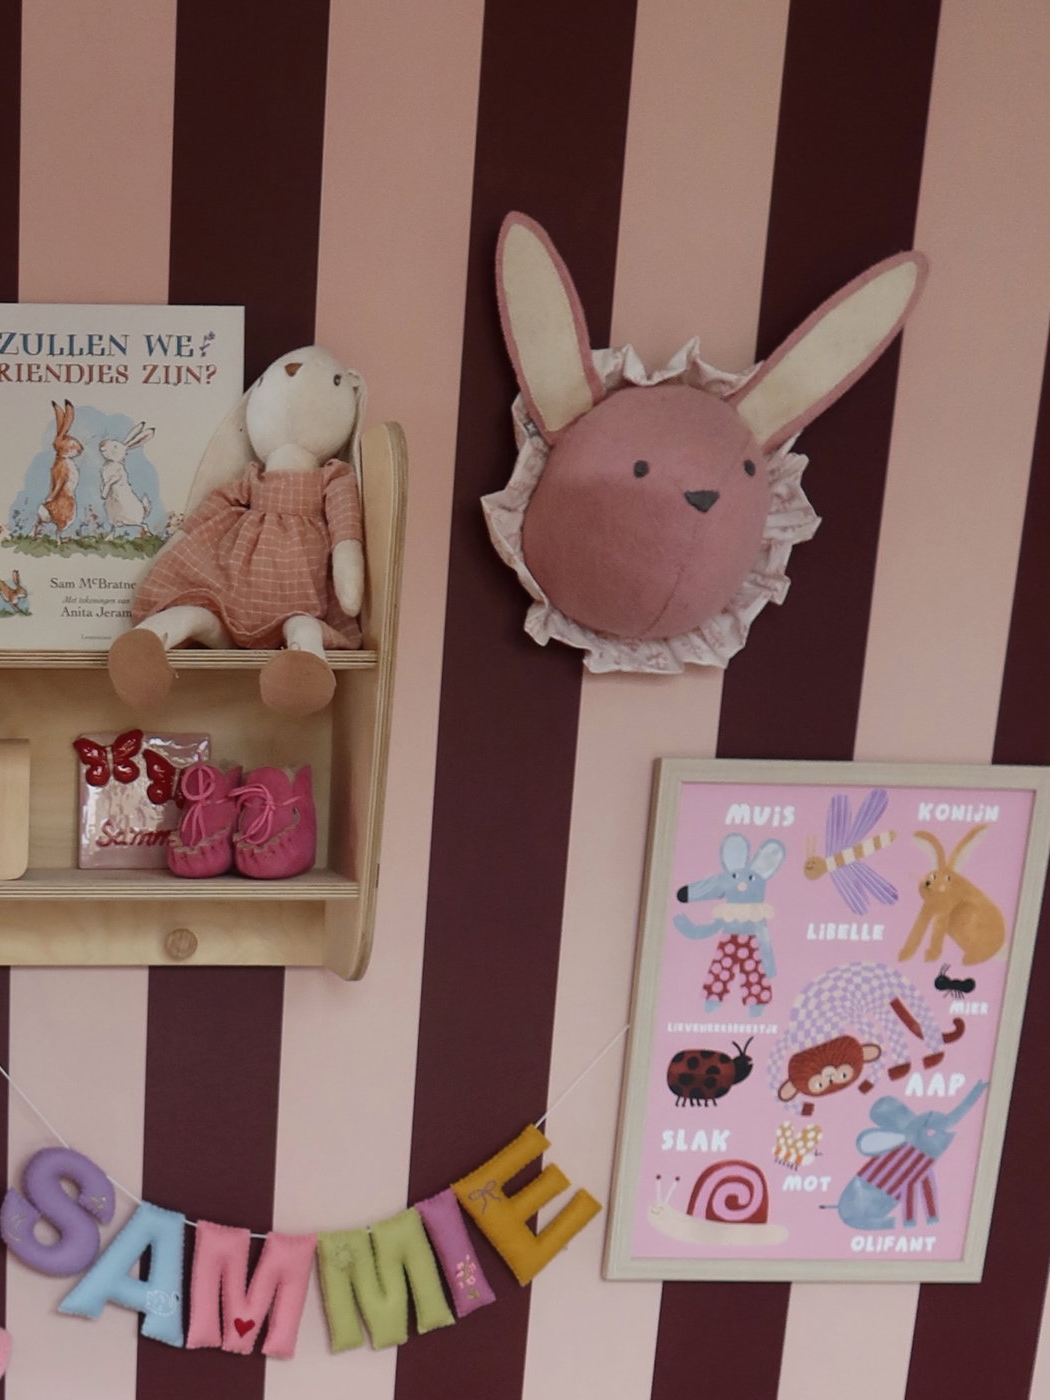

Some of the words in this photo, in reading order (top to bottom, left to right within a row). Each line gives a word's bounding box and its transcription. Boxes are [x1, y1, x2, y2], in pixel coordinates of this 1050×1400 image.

[144, 334, 194, 357] WE
[142, 364, 217, 386] ZIJN?
[50, 577, 75, 589] Sam
[61, 606, 93, 617] Anita
[95, 606, 134, 618] Jeram
[949, 1000, 989, 1016] MIER
[905, 1073, 966, 1097] AAP
[661, 1129, 731, 1152] SLAK
[782, 1174, 832, 1192] MOT
[0, 1123, 602, 1360] SAMMIE
